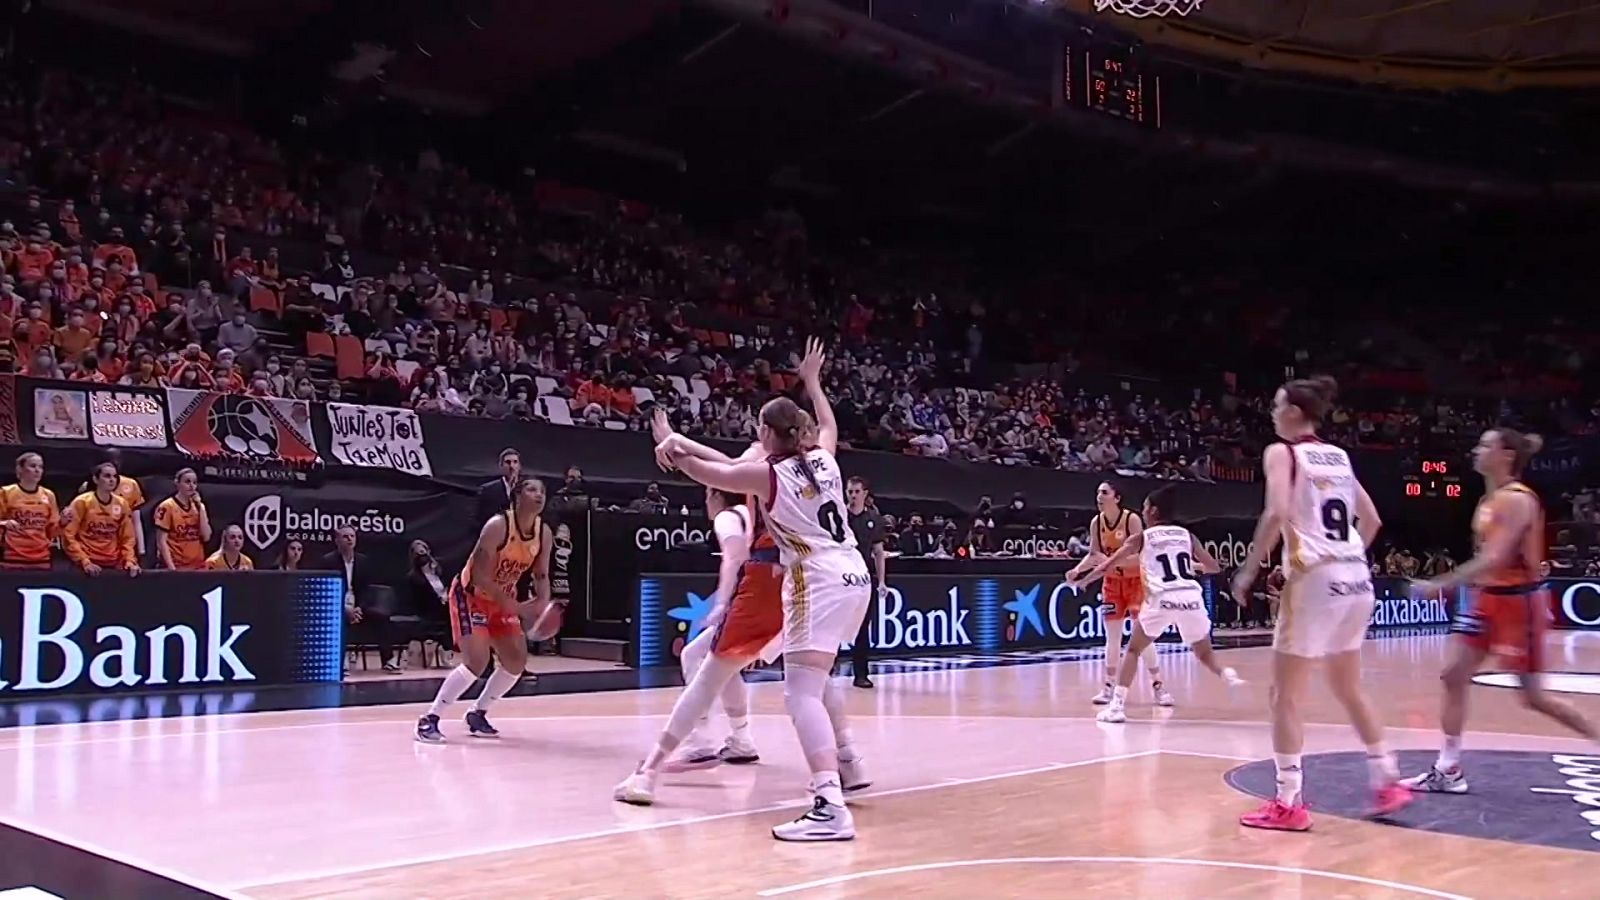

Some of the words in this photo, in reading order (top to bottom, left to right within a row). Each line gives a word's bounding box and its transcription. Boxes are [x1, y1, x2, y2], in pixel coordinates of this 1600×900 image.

[817, 500, 847, 543] 0
[1322, 498, 1349, 541] 9
[1156, 552, 1195, 582] 10
[840, 586, 973, 650] Bank
[1372, 588, 1449, 625] aixaBank
[0, 586, 256, 690] Bank
